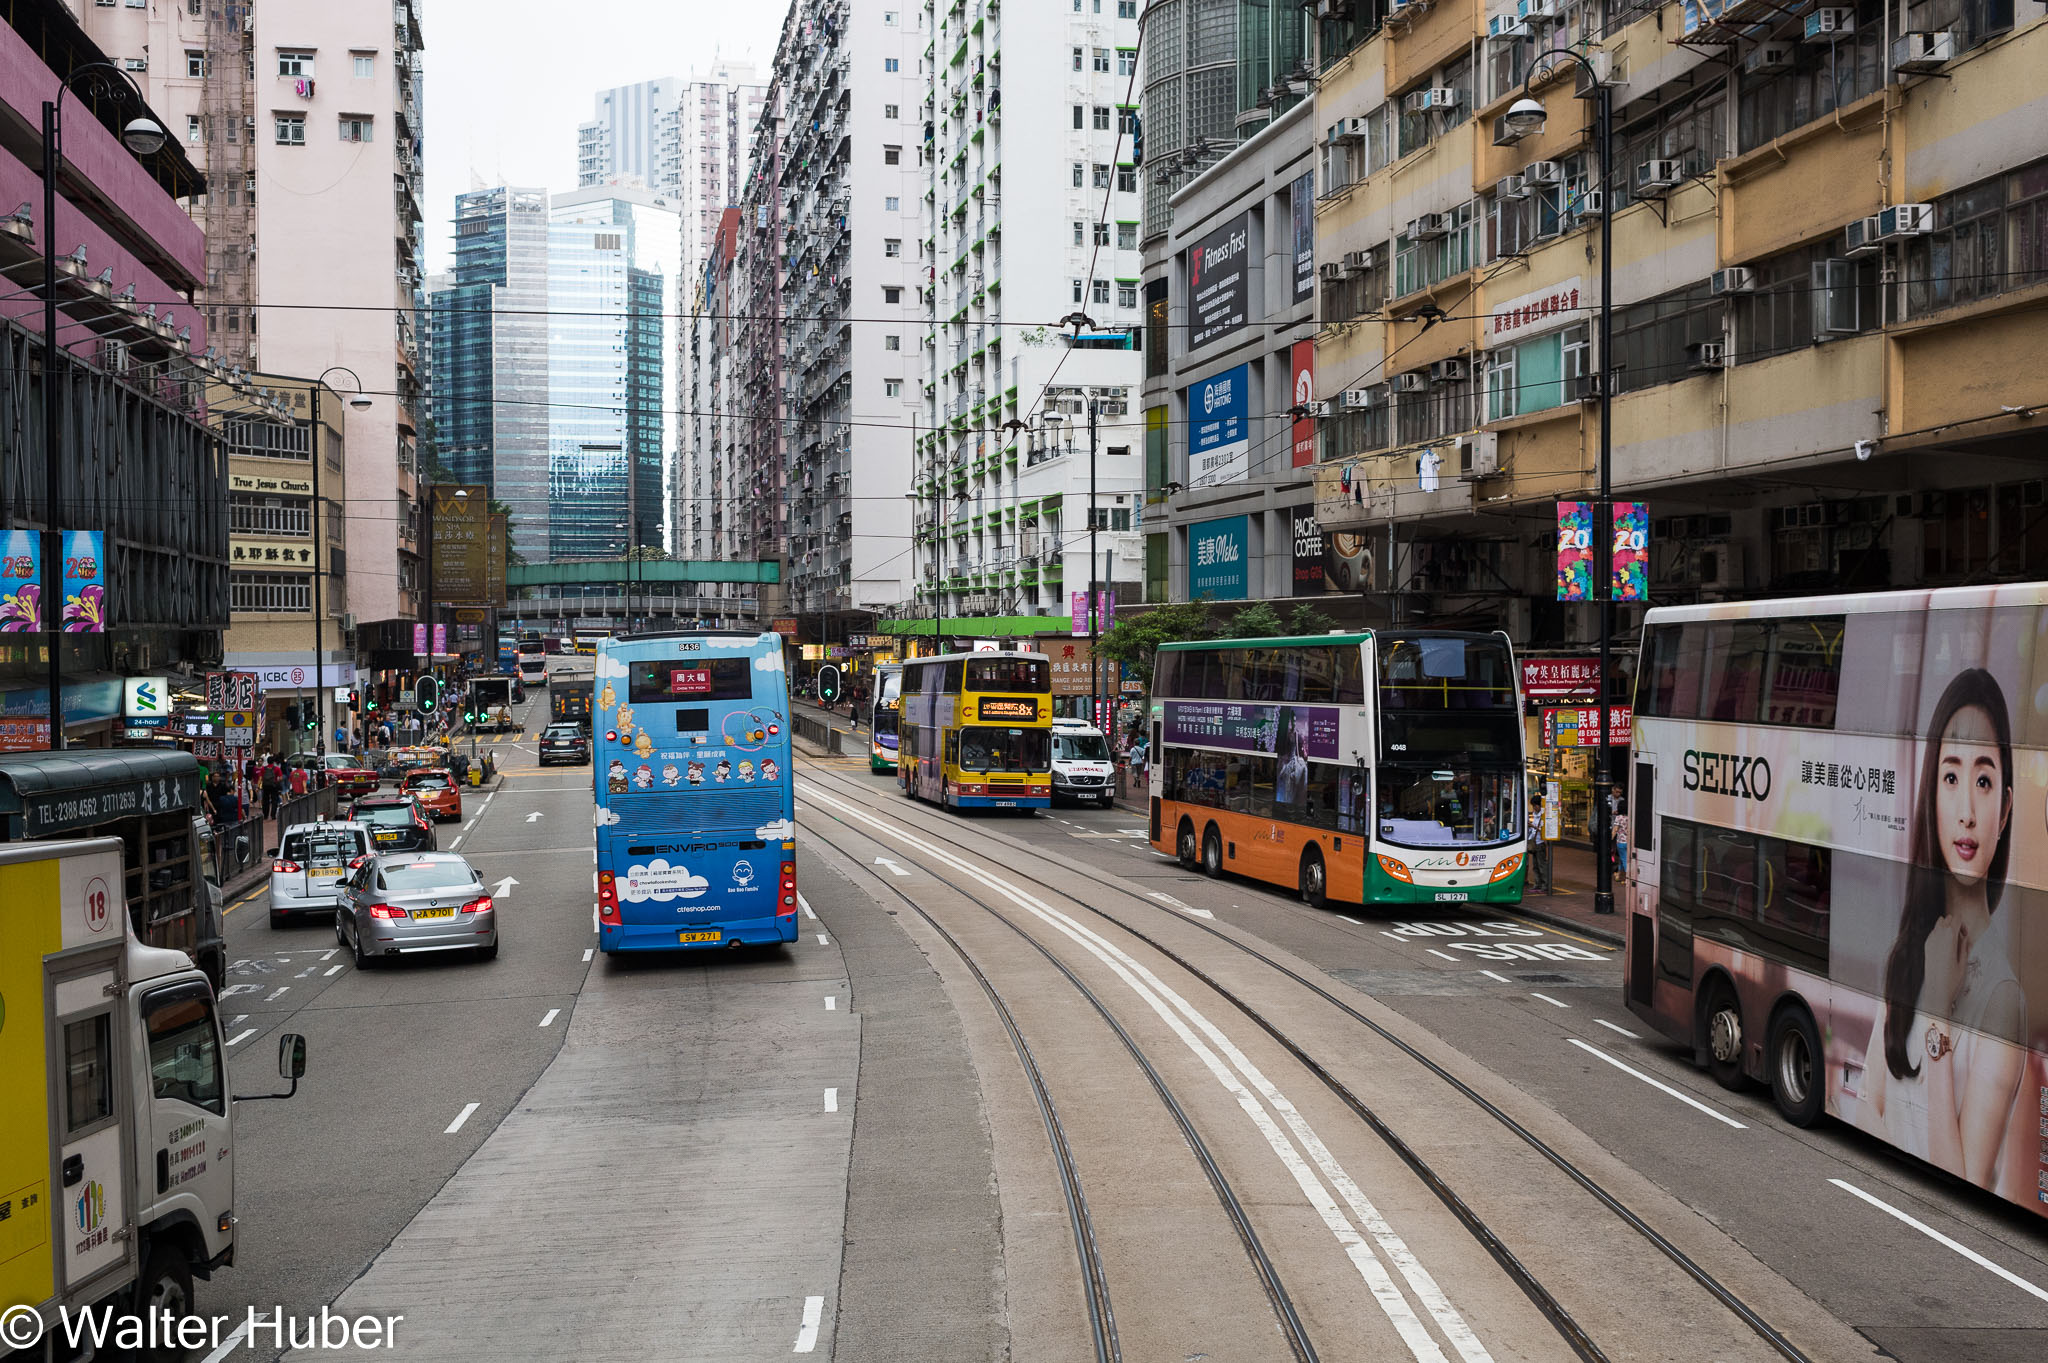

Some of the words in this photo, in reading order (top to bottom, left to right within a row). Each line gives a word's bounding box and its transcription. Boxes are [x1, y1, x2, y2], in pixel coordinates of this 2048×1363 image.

[1204, 242, 1229, 274] Fitness
[1229, 229, 1246, 260] First
[233, 476, 253, 487] True
[256, 478, 277, 490] Jesus
[281, 480, 310, 491] Church
[1295, 537, 1322, 557] COFFEE
[1559, 529, 1589, 550] 20
[1615, 530, 1645, 551] 20
[1197, 536, 1215, 566] 美康
[263, 671, 288, 682] ICBC
[676, 672, 706, 683] 周大福
[1683, 748, 1771, 802] SEIKO
[1801, 760, 1896, 795] 讓美麗從心閃耀
[79, 797, 98, 817] 4562
[1471, 854, 1487, 862] 新巴
[88, 888, 106, 920] 18
[1437, 893, 1446, 901] SL
[1449, 893, 1467, 901] 1271
[416, 910, 429, 919] RA
[429, 908, 451, 917] 9701
[676, 905, 721, 913] ctfeshop.com
[685, 933, 697, 941] SW
[699, 932, 716, 940] 271
[1446, 942, 1612, 961] BUS
